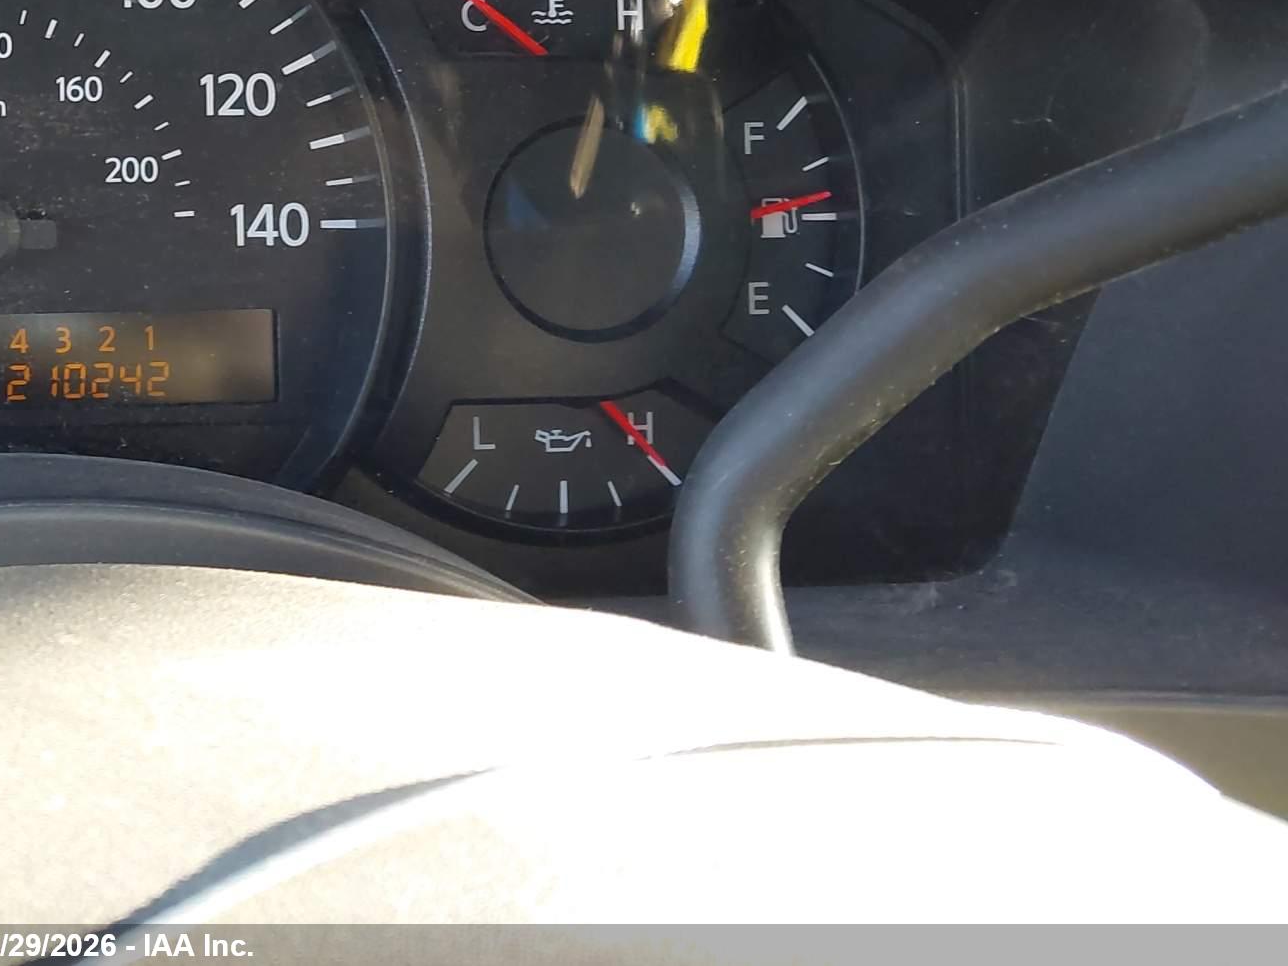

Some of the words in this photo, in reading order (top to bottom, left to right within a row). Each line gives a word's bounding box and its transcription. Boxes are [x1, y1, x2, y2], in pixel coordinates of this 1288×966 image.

[460, 0, 488, 32] C
[56, 76, 103, 104] 160
[200, 72, 276, 118] 120
[744, 122, 764, 154] F
[105, 156, 158, 184] 200
[230, 201, 310, 248] 140
[748, 282, 768, 315] E
[9, 328, 29, 354] 4
[55, 327, 72, 354] 3
[99, 326, 116, 352] 2
[144, 325, 154, 351] 1
[7, 361, 169, 402] 210242
[473, 417, 496, 451] L
[627, 412, 655, 446] H
